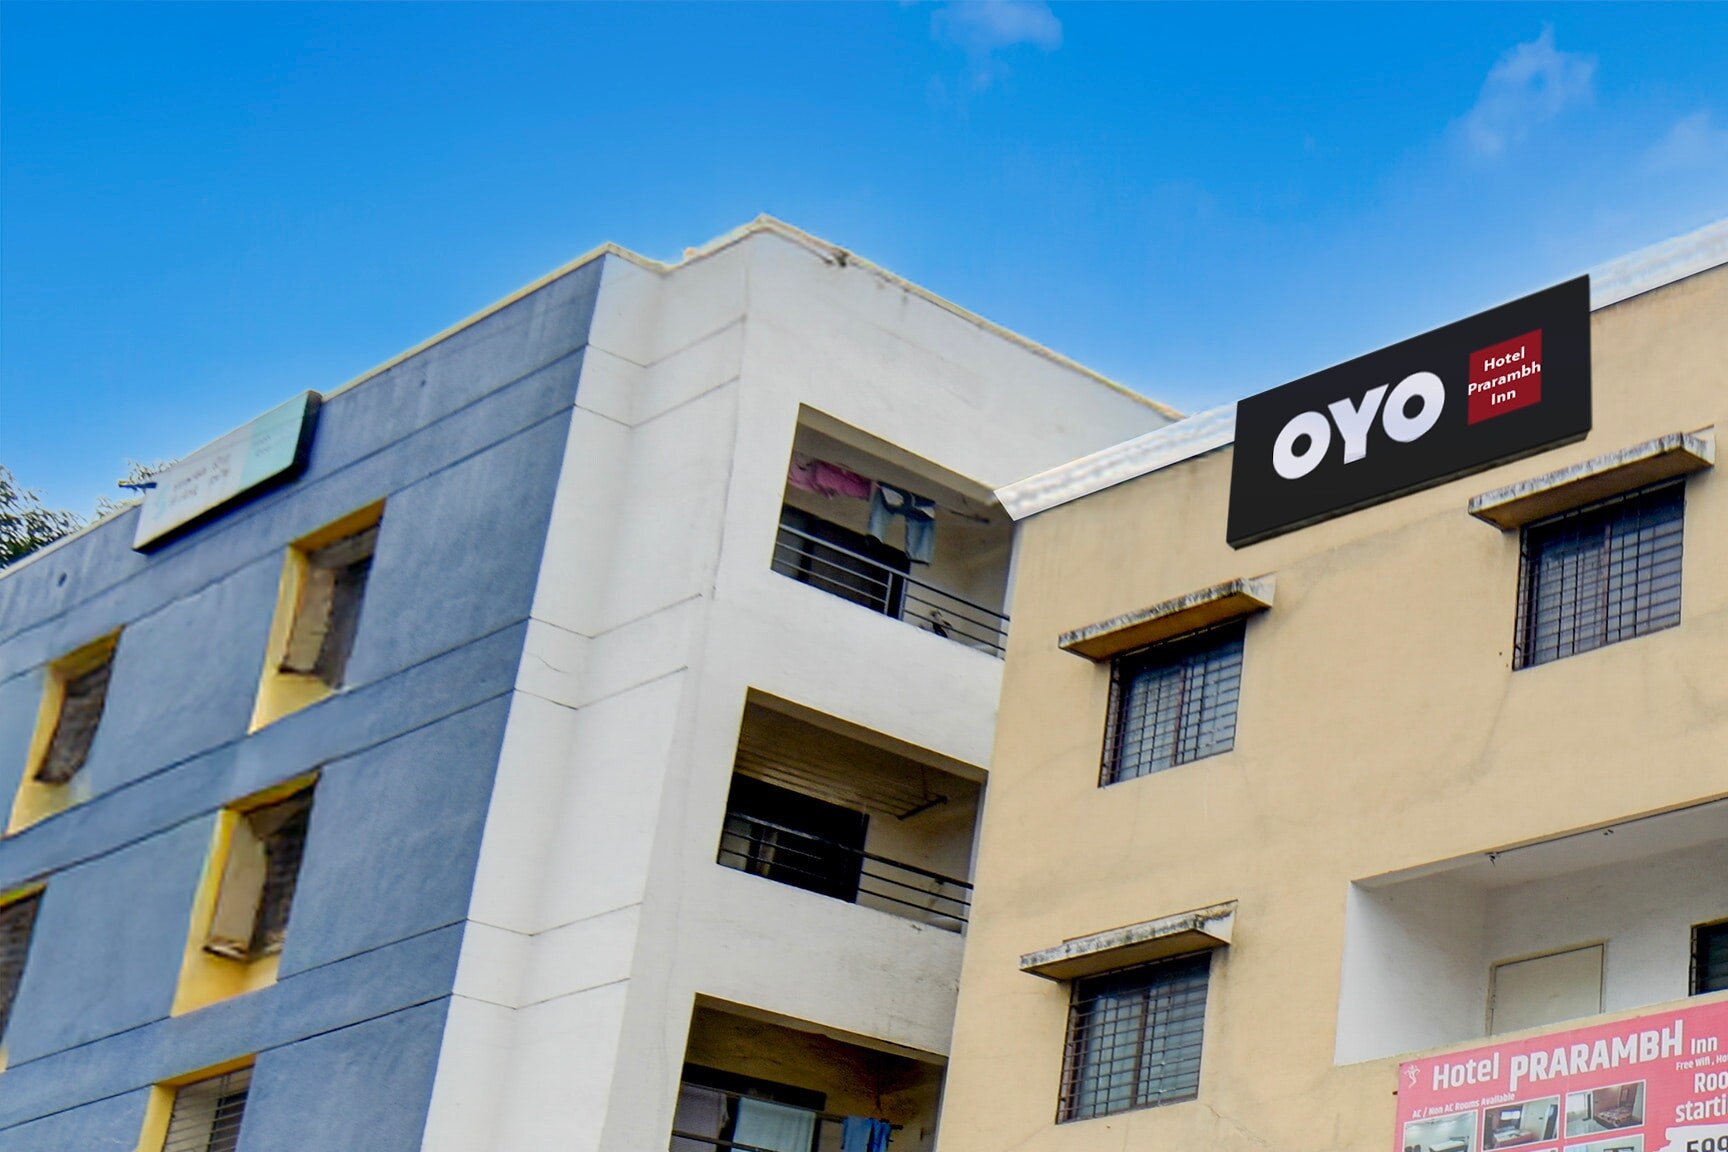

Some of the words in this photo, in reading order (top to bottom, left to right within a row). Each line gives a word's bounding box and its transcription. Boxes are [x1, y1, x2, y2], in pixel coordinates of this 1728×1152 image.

[1484, 345, 1525, 372] Hotel
[1467, 360, 1541, 396] Prarambh
[1491, 389, 1516, 406] Inn
[1272, 371, 1446, 480] OYO
[1433, 1052, 1500, 1091] Hotel
[1509, 1020, 1684, 1092] PRARAMBH
[1691, 1036, 1718, 1055] Inn
[1676, 1059, 1694, 1071] Free
[1412, 1109, 1422, 1119] AC
[1428, 1105, 1443, 1116] Non
[1444, 1103, 1454, 1113] AC
[1455, 1099, 1480, 1111] Rooms
[1481, 1092, 1515, 1107] Available
